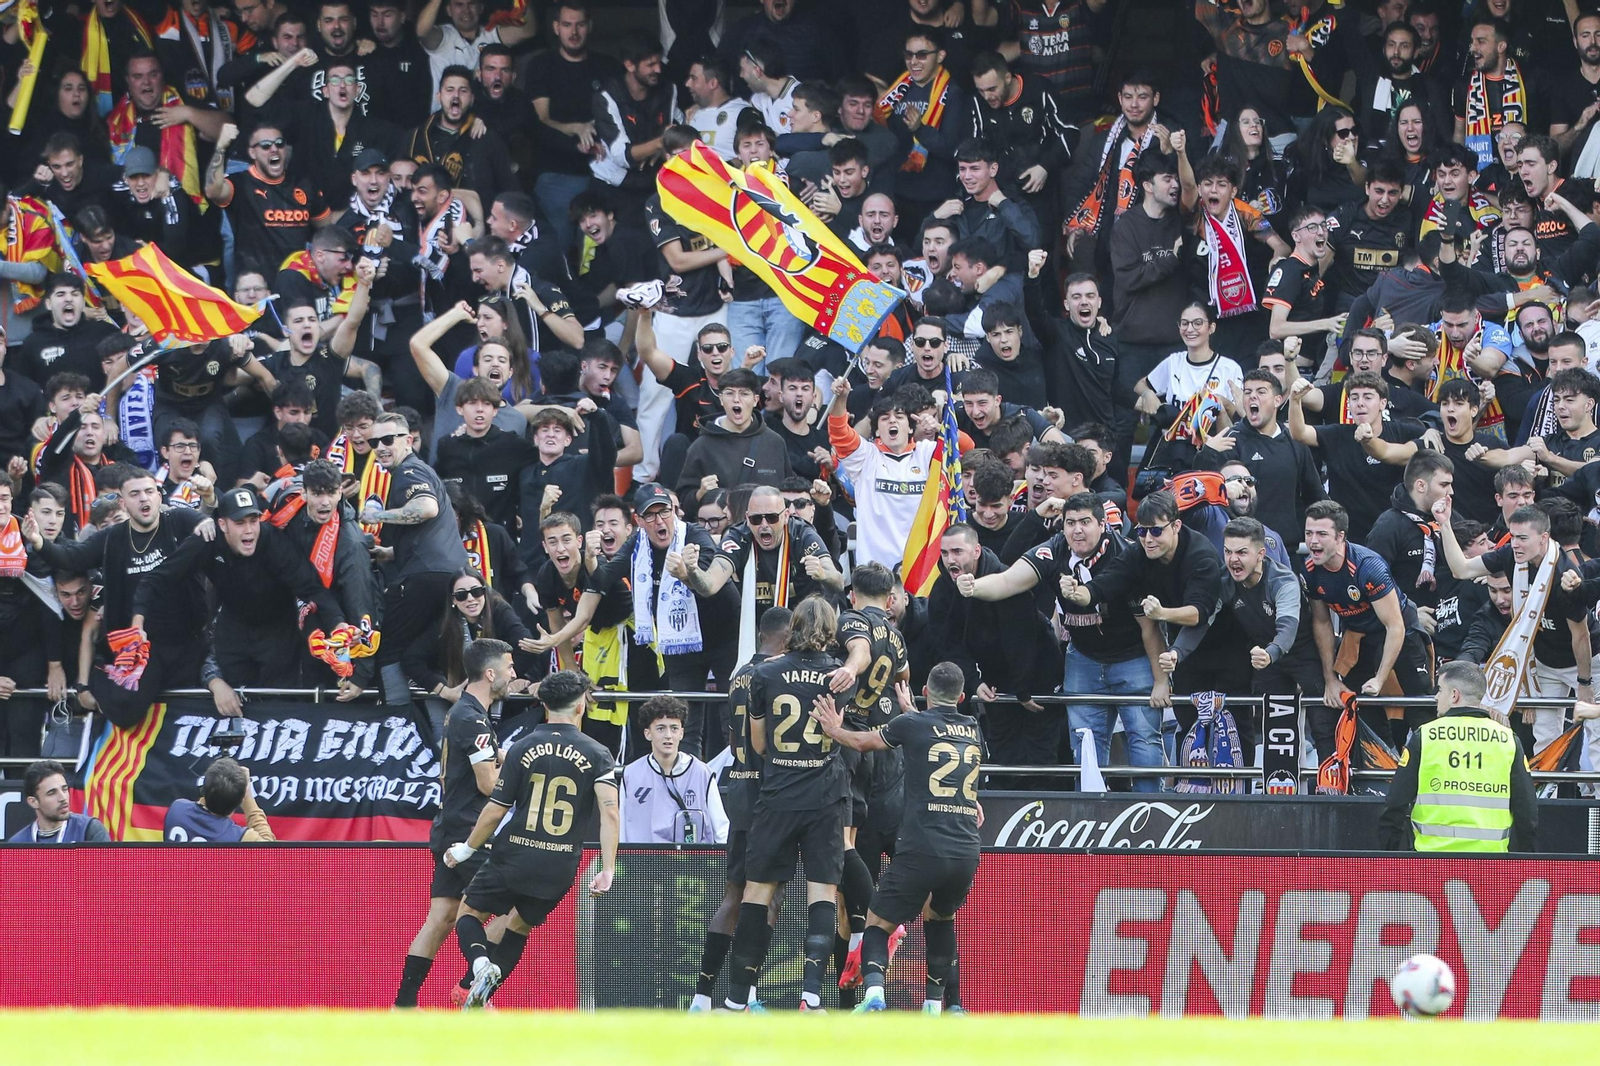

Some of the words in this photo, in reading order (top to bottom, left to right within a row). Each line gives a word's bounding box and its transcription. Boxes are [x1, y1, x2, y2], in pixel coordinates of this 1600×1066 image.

[1357, 253, 1372, 262] TM
[758, 588, 772, 596] TM
[782, 670, 828, 686] YAREK
[856, 655, 893, 708] 9
[773, 694, 835, 753] 24
[1429, 726, 1508, 743] SEGURIDAD
[521, 742, 553, 769] DIEGO
[556, 744, 593, 773] LÓPEZ
[1449, 751, 1482, 769] 611
[928, 743, 982, 801] 22
[1444, 780, 1508, 794] PROSEGUR
[525, 772, 577, 836] 16
